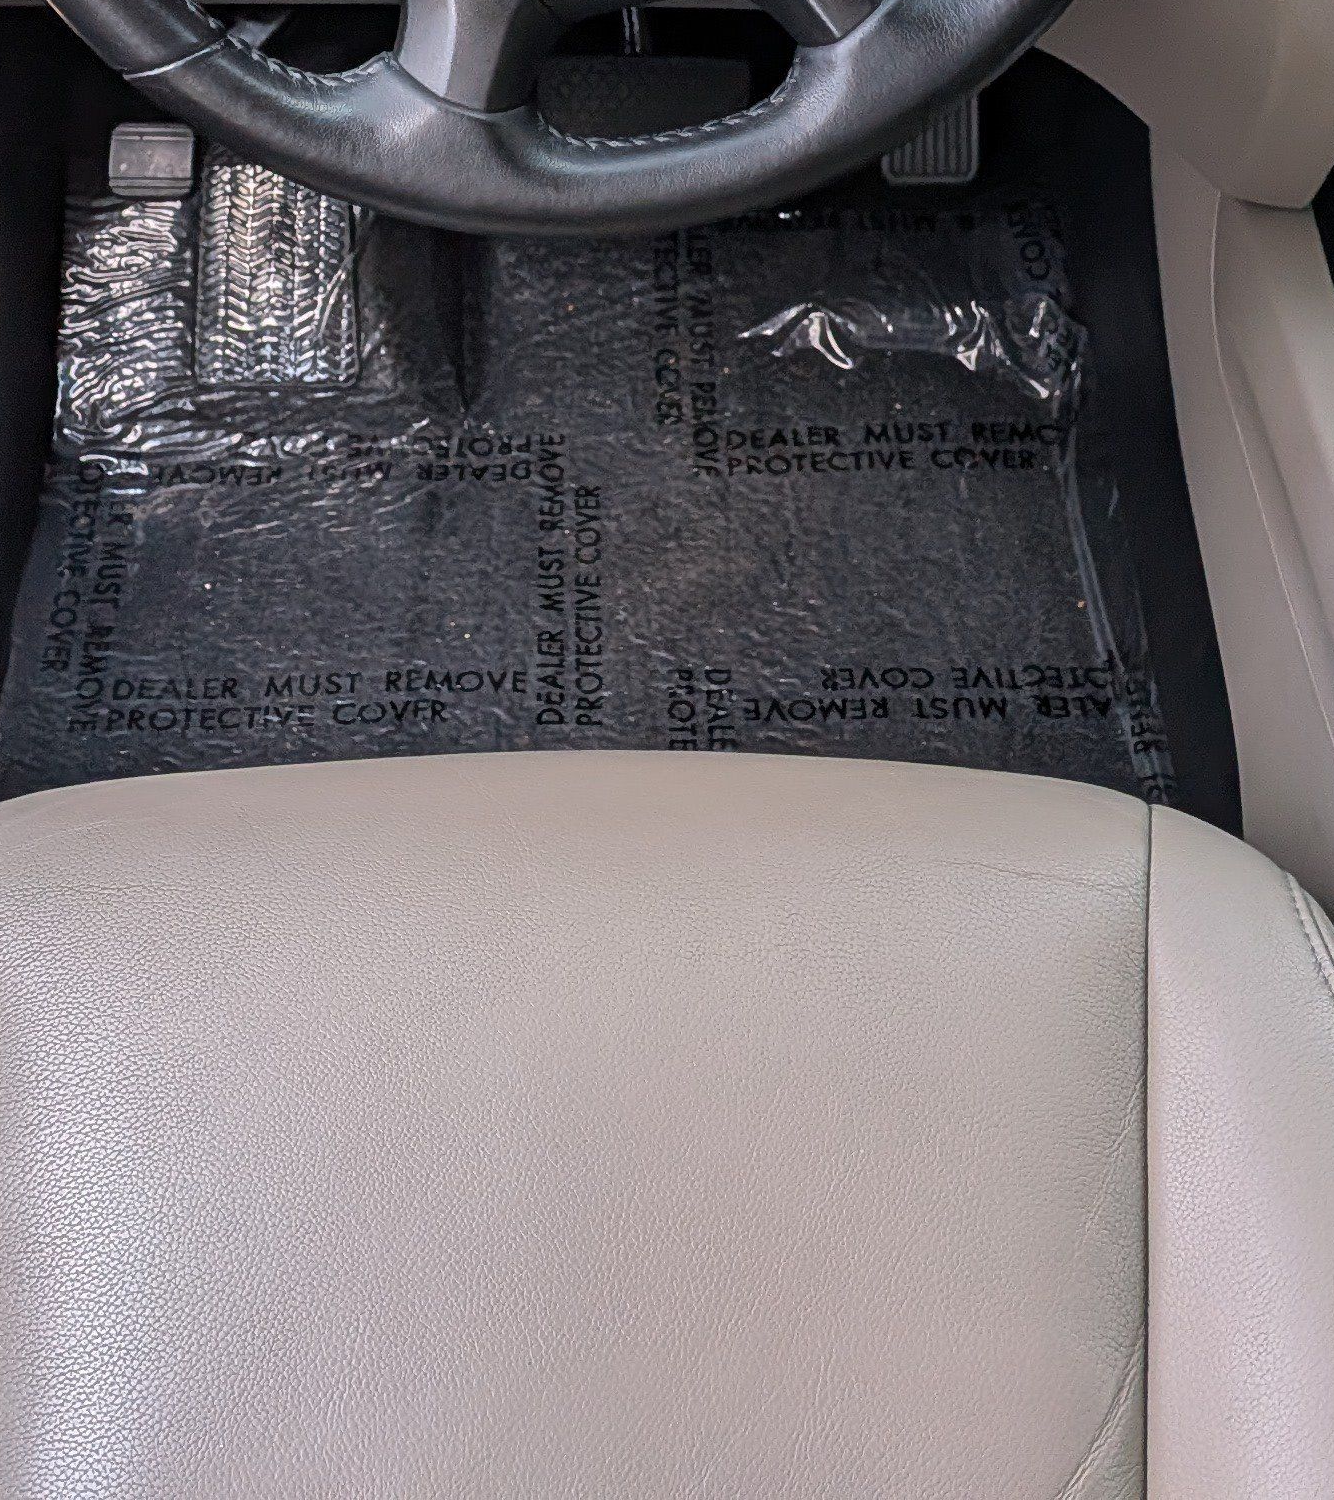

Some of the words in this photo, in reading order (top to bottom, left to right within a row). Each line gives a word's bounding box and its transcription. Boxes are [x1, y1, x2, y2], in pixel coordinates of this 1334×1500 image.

[726, 425, 842, 451] DEALER
[866, 421, 953, 444] MUST
[417, 460, 532, 483] DEALER
[727, 450, 916, 476] PROTECTIVE
[931, 448, 1037, 470] COVER
[539, 433, 566, 532] REMOVE
[574, 484, 603, 565] COVER
[537, 547, 566, 612] MUST
[574, 573, 604, 727] PROTECTIVE
[110, 676, 239, 701] DEALER
[266, 671, 363, 698] MUST
[384, 668, 529, 694] REMOVE
[536, 630, 566, 726] DEALER
[820, 667, 934, 692] COVER
[107, 703, 316, 732] PROTECTIVE
[331, 699, 449, 727] COVER
[744, 696, 889, 722] REMOVE
[912, 695, 1008, 720] MUST
